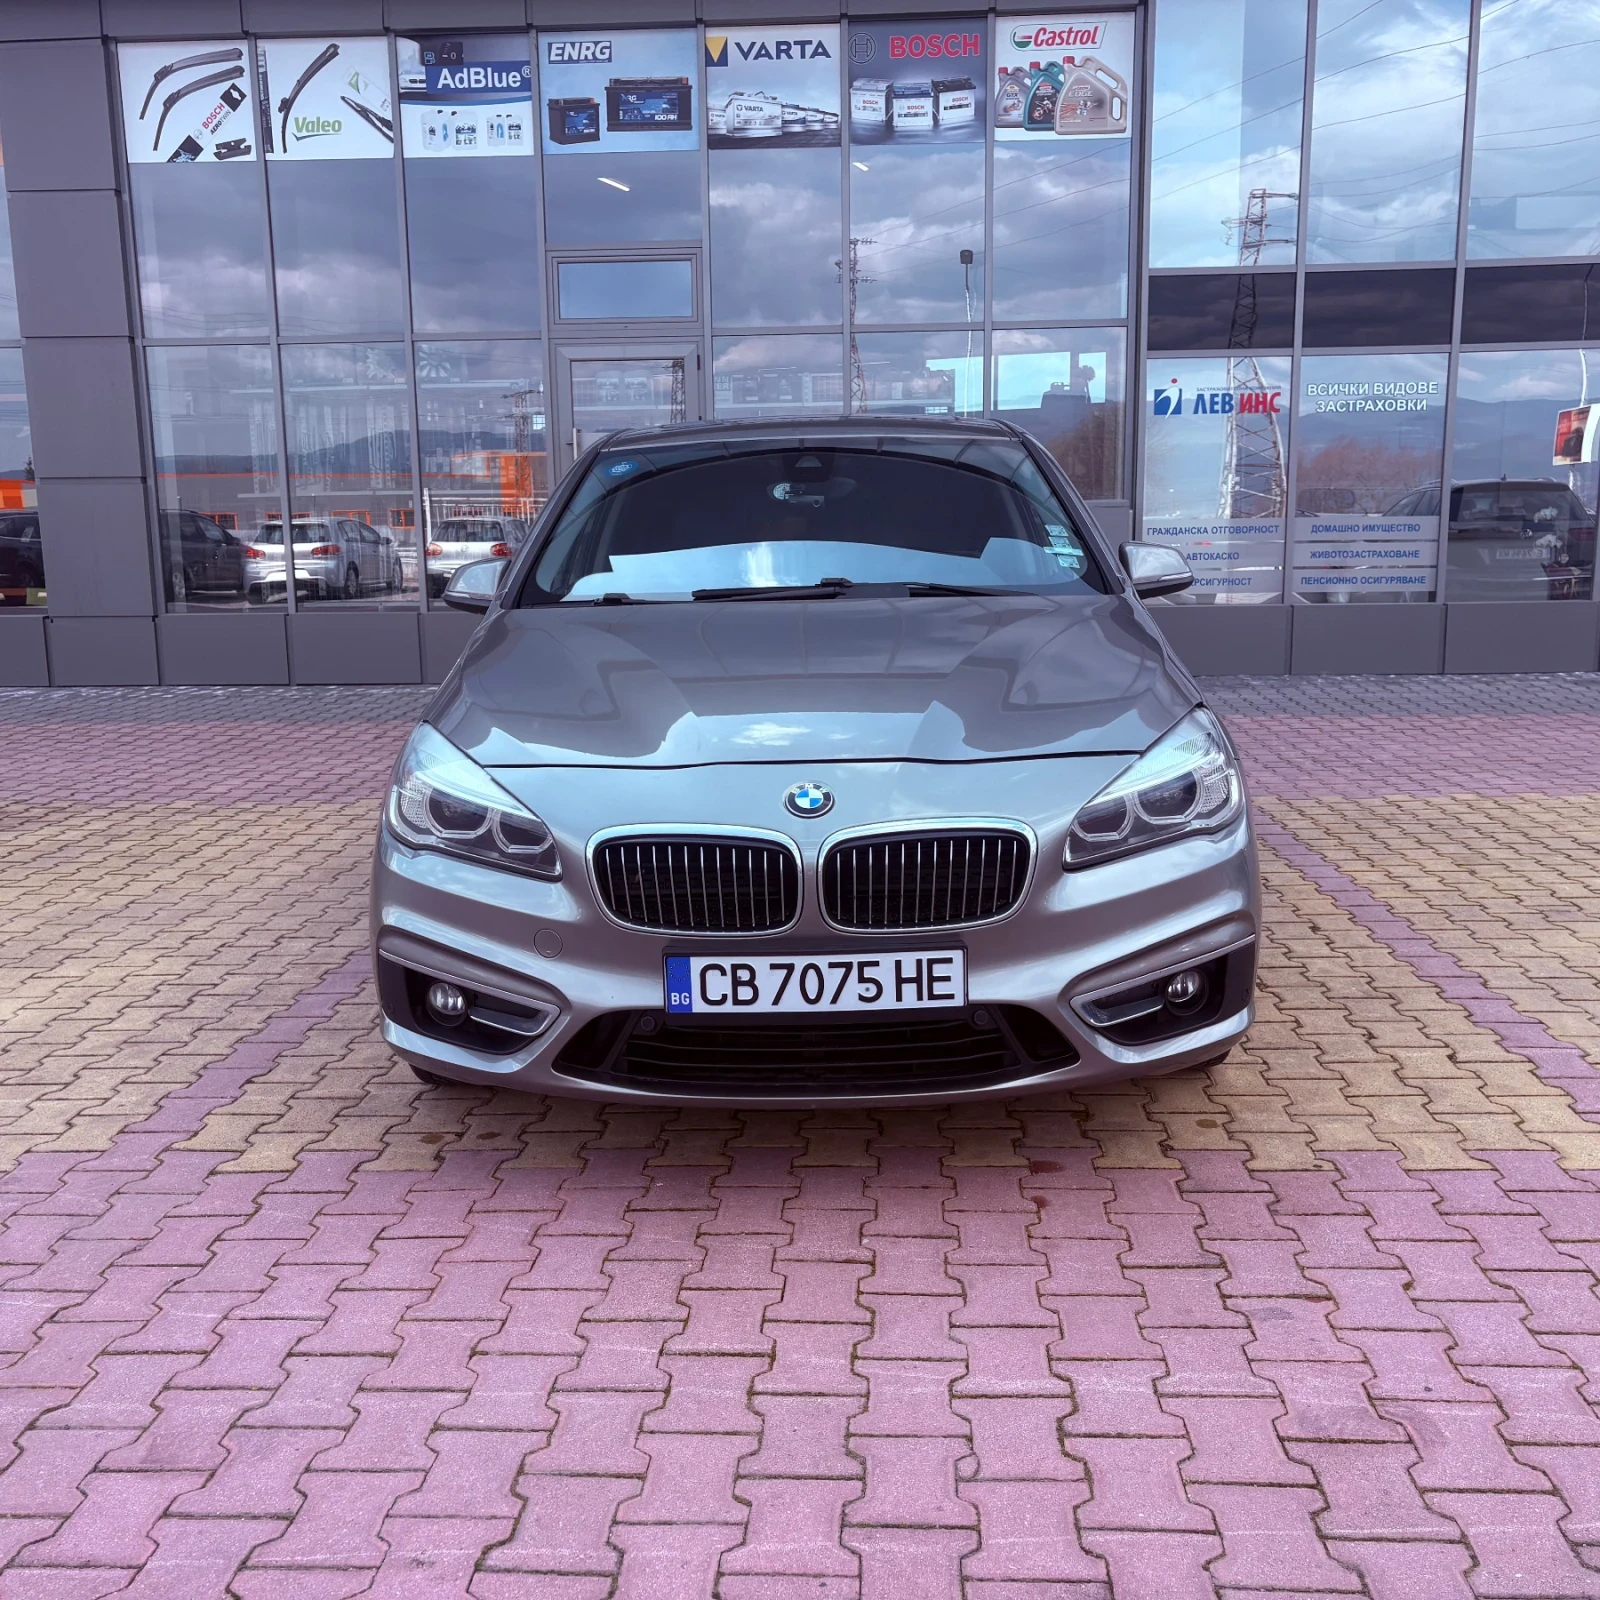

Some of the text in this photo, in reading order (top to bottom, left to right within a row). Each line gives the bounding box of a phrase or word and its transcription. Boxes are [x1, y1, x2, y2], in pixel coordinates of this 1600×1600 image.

[1033, 26, 1099, 48] Castrol
[550, 41, 611, 61] ENRG
[734, 40, 832, 61] VARTA
[889, 33, 980, 59] BOSCH
[202, 102, 226, 130] BOSCH
[744, 105, 764, 113] VARTA
[294, 117, 342, 133] Valeo
[1307, 381, 1438, 396] ВСИЧКИ ВИДОВЕ
[1193, 392, 1281, 414] ЛЕВ ИНС
[1316, 399, 1427, 413] ЗАСТРАХОВКИ
[1147, 525, 1279, 536] ГРАЖДАНСКА ОТГОВОРНОСТ
[1311, 523, 1421, 534] ДОМАШНО ИМУЩЕСТВО
[1186, 552, 1240, 561] АВТОКАСКО
[1310, 550, 1420, 559] ЖИВОТОЗАСТРАХОВАНЕ
[1192, 578, 1252, 586] РСИГУРНОСТ
[1301, 576, 1426, 585] ПЕНСИОННО ОСИГУРЯВАНЕ
[699, 957, 955, 1006] CB 7075 HE
[671, 992, 690, 1006] BG
